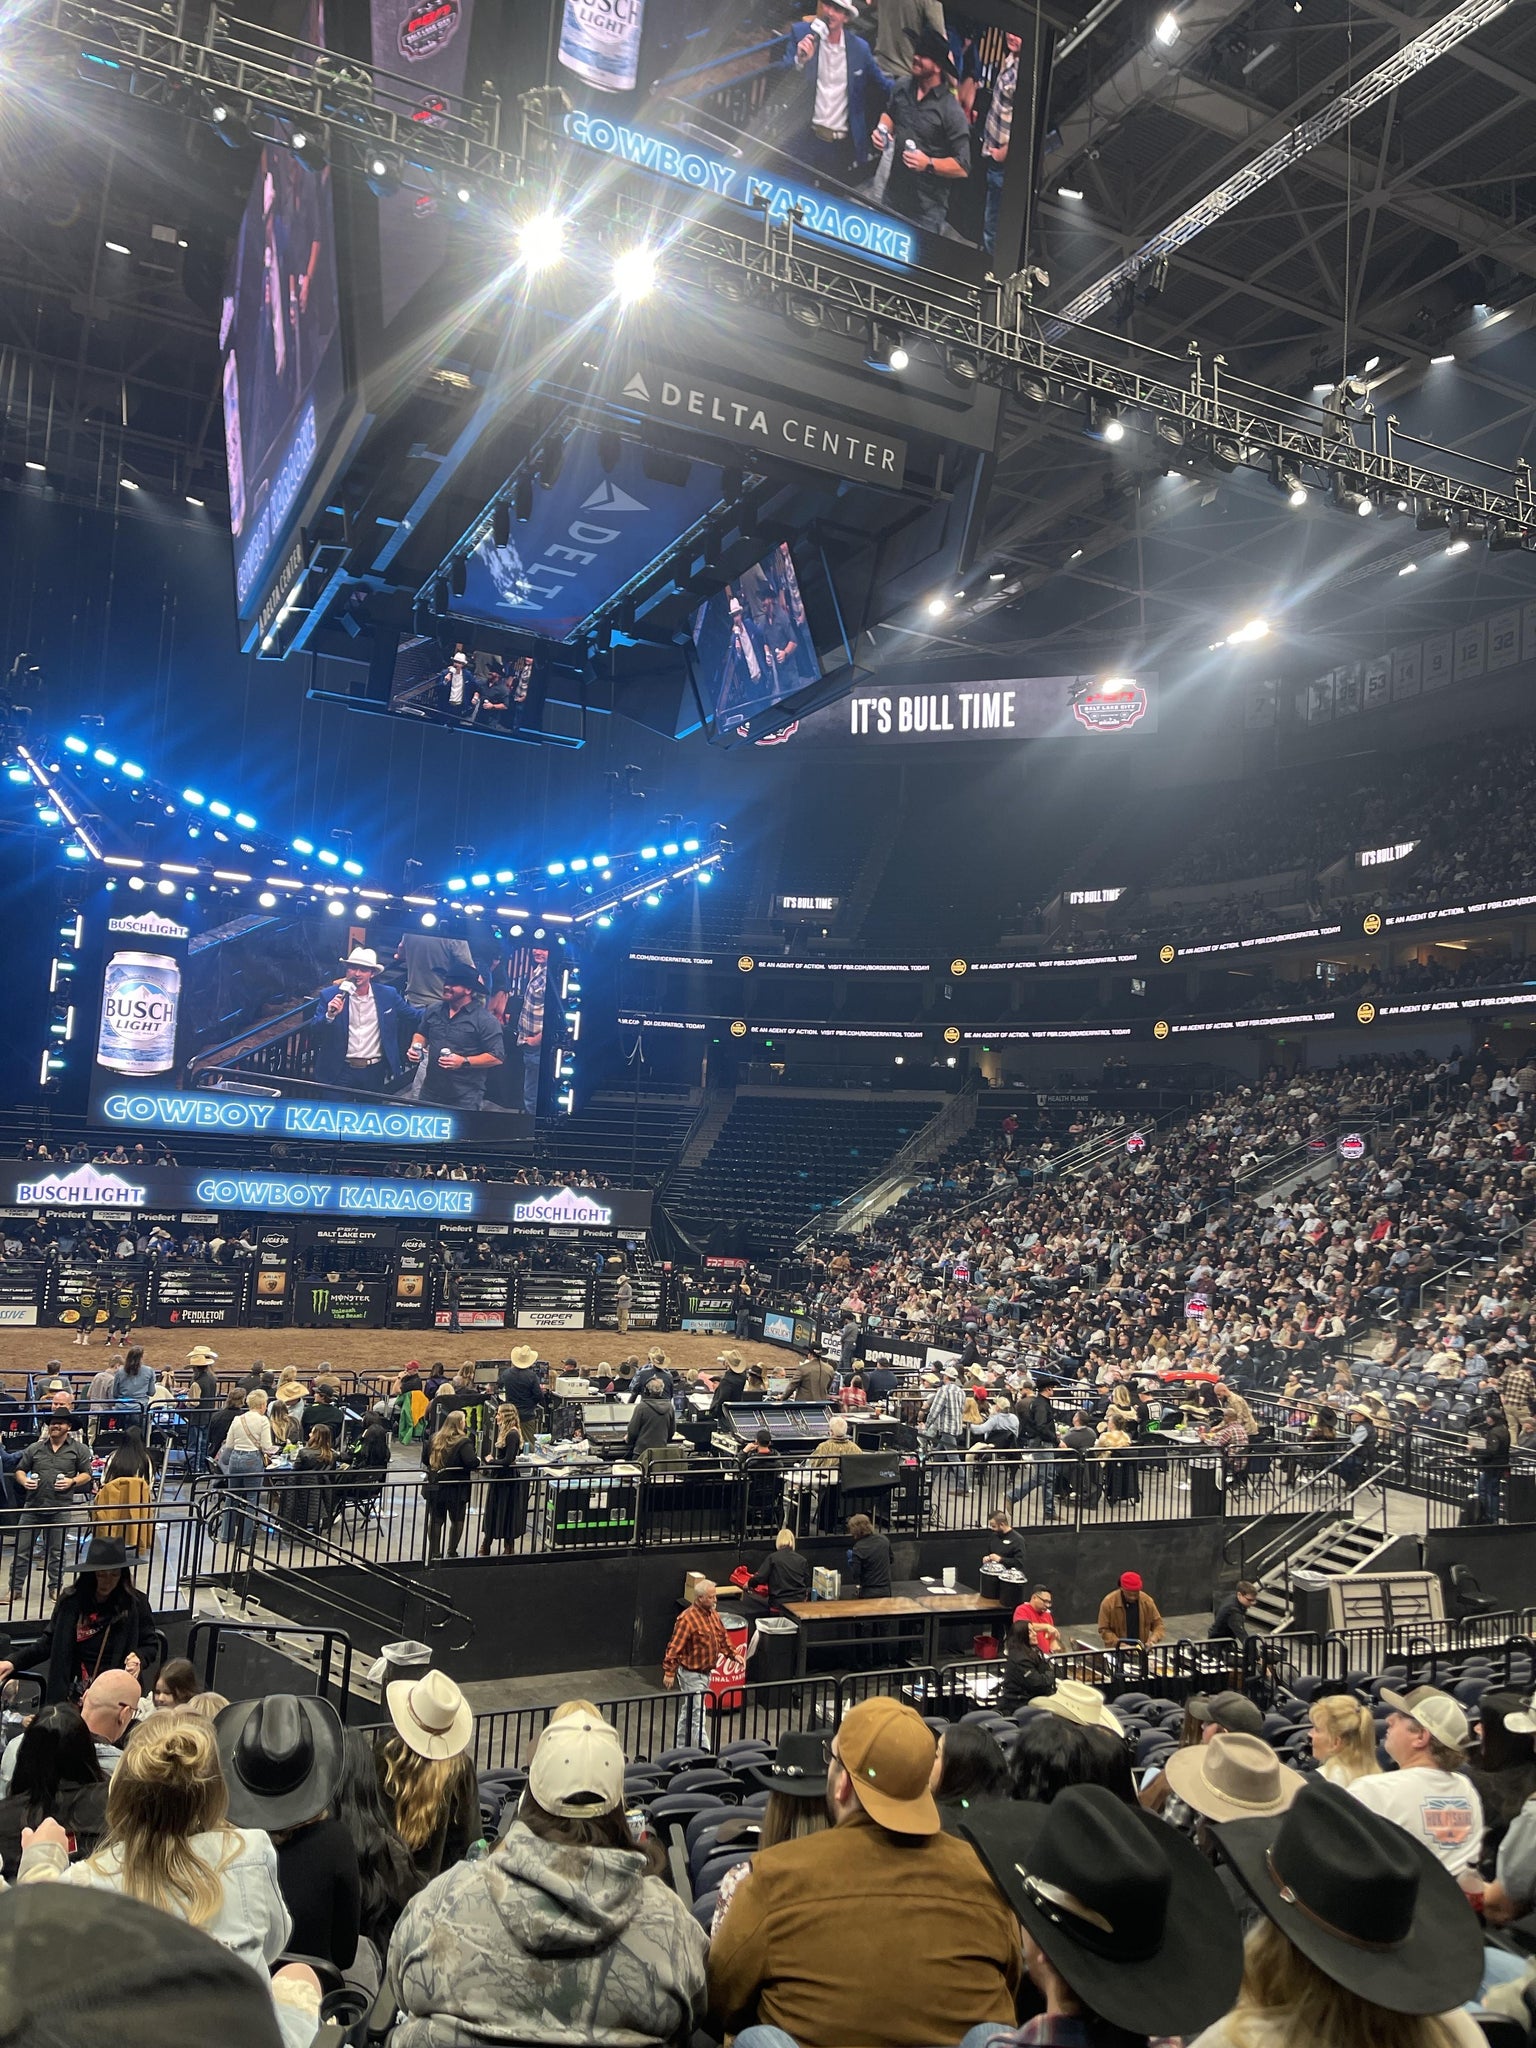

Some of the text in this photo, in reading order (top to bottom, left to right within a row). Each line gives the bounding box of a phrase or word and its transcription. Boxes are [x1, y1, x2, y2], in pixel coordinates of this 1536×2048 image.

[580, 8, 627, 34] LIGHT
[563, 110, 911, 264] COWBOY KARAOKE
[661, 382, 895, 472] DELTA CENTER
[279, 543, 302, 596] CENTER
[1494, 630, 1514, 651] 32
[1461, 643, 1478, 662] 12
[1432, 654, 1442, 671] 9
[1368, 673, 1386, 694] 53
[850, 691, 1016, 734] IT'S BULL TIME
[1376, 846, 1395, 864] BULL
[797, 897, 815, 909] BULL
[815, 897, 833, 910] TIME
[1084, 890, 1102, 904] BULL
[105, 998, 174, 1023] BUSCH
[116, 1019, 162, 1033] LIGHT
[104, 1095, 452, 1139] COWBOY KARAOKE
[197, 1179, 473, 1213] COWBOY KARAOKE
[45, 1210, 87, 1219] Priefert
[137, 1213, 177, 1221] Priefert
[440, 1224, 473, 1233] Priefert
[513, 1227, 544, 1236] Priefert
[583, 1229, 613, 1238] Priefert
[262, 1236, 280, 1244] LUCAS
[182, 1309, 225, 1321] PENDLETON
[893, 1353, 921, 1368] BARN
